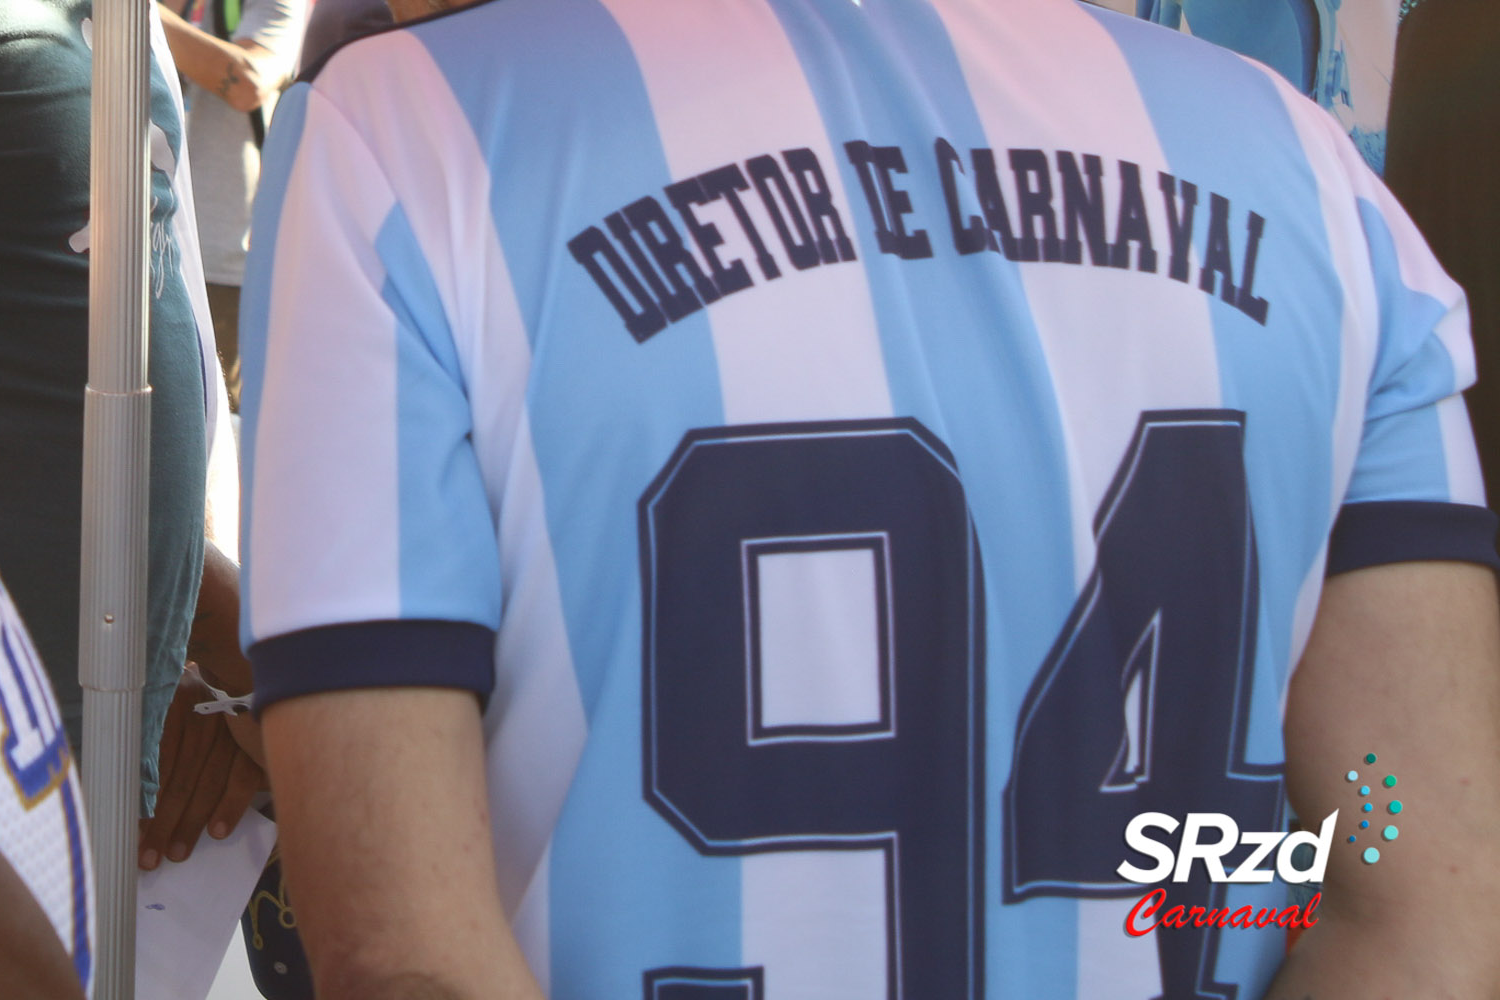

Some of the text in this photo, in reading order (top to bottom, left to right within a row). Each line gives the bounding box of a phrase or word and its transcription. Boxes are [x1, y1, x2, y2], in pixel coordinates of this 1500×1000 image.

[566, 136, 1269, 345] DIRETOR DE CARNAVAL
[637, 408, 1288, 1000] 94
